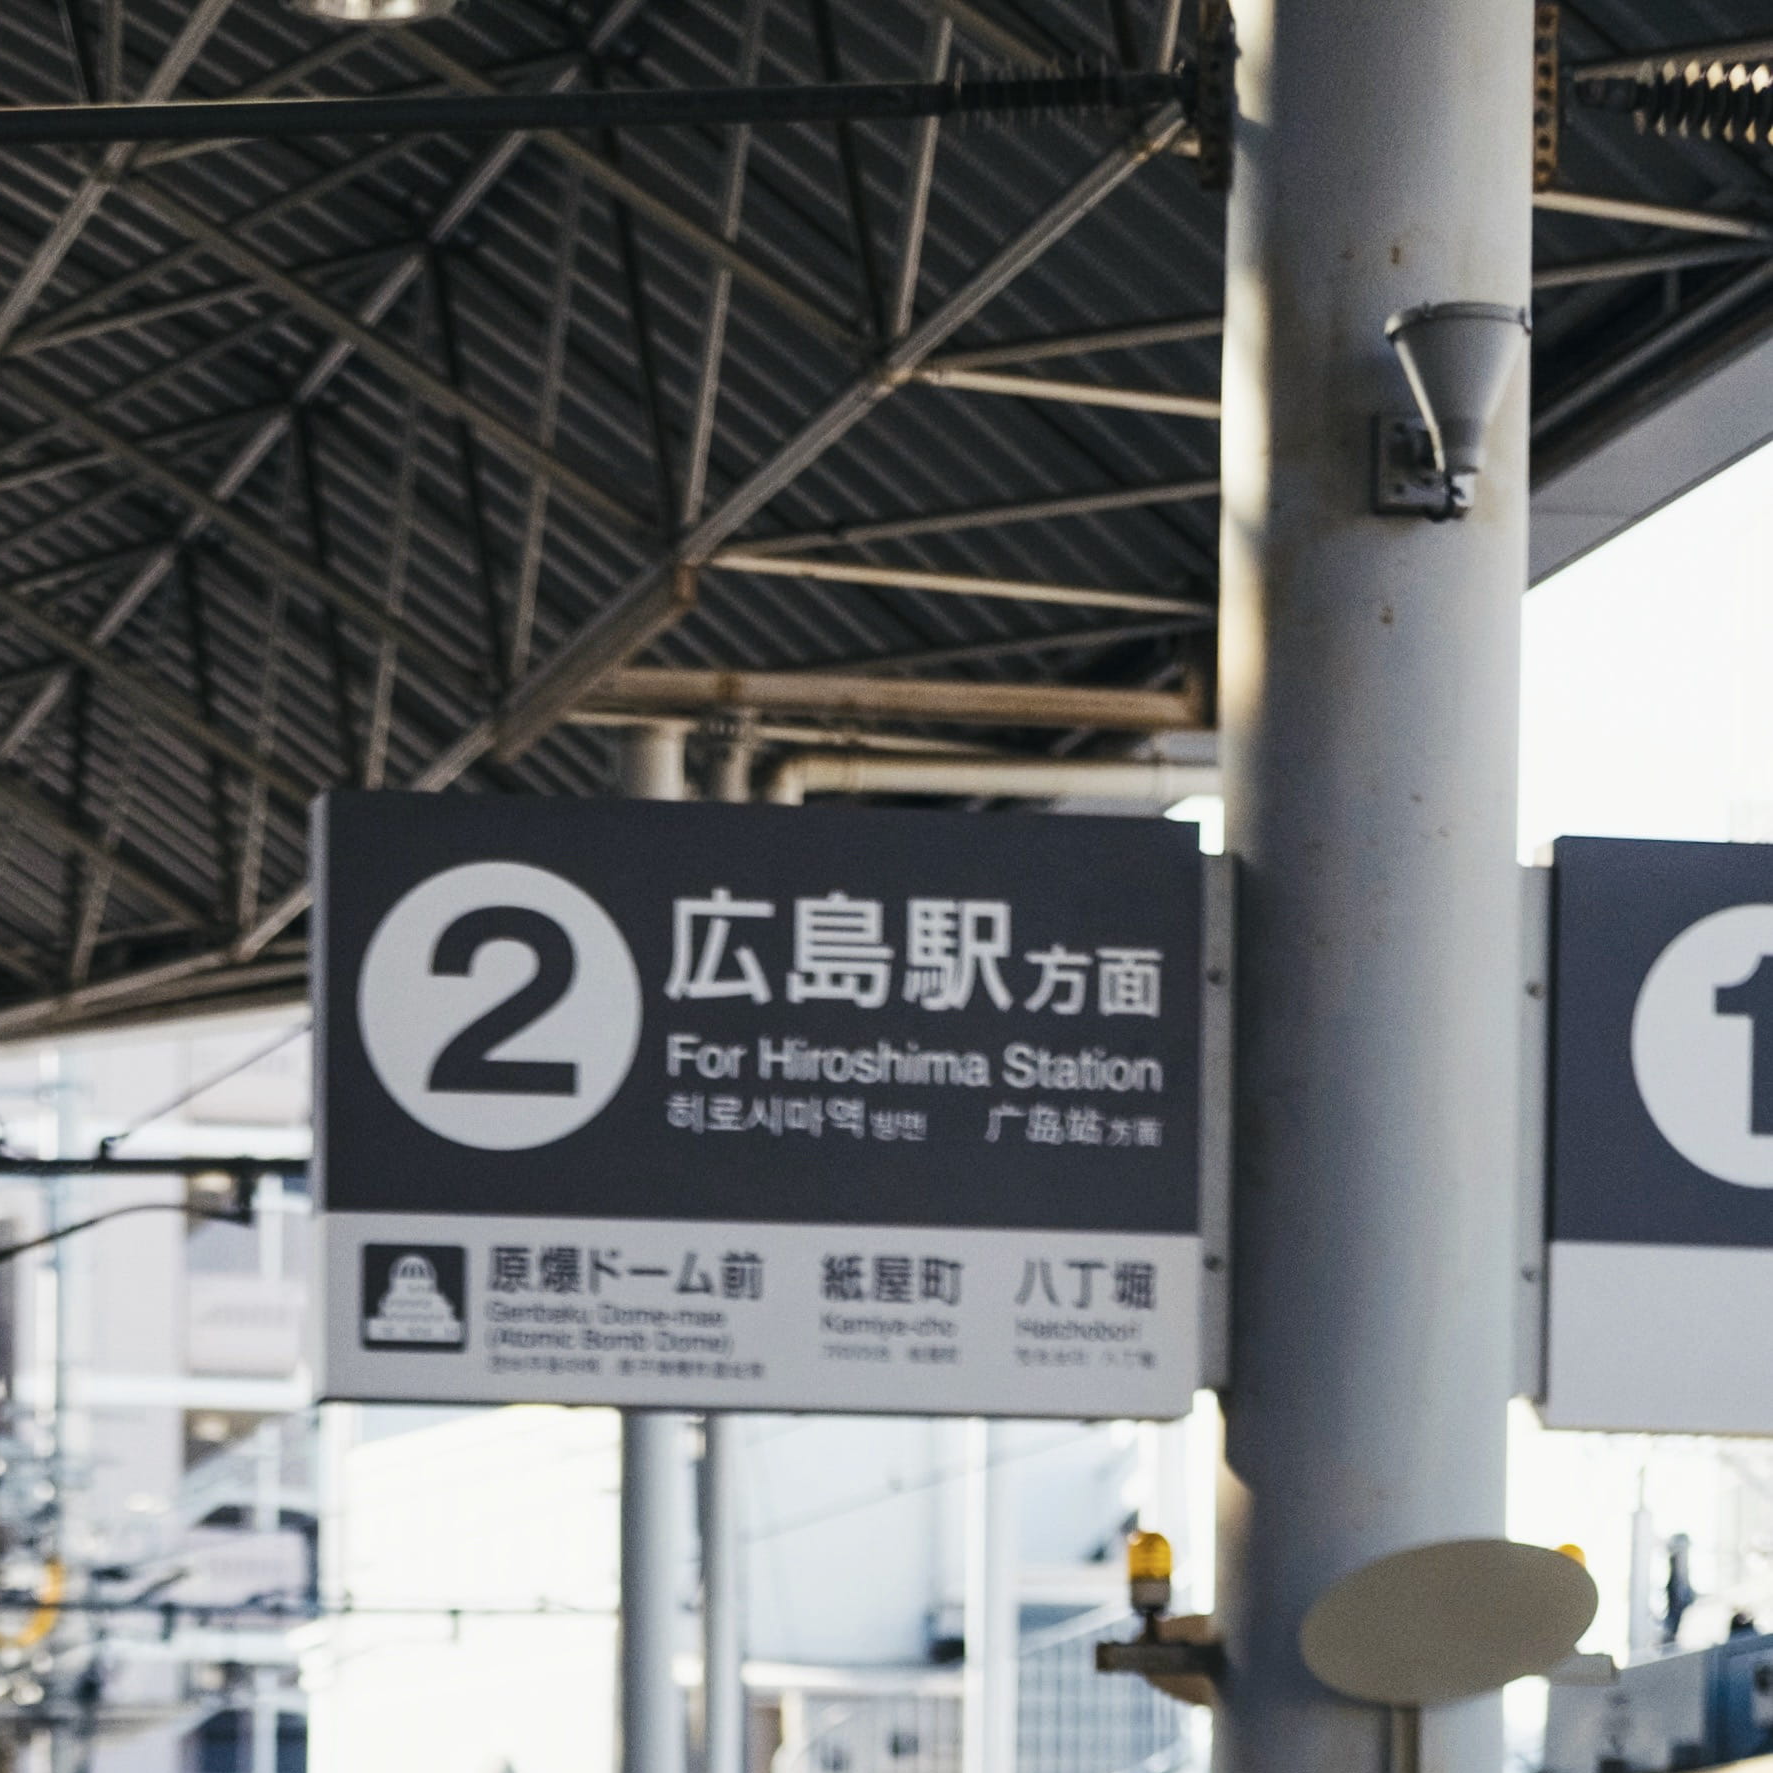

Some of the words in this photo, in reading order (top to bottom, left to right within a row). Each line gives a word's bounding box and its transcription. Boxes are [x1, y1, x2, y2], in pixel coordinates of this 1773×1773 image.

[664, 887, 1164, 1018] 広島駅方面
[426, 905, 578, 1096] 2
[666, 1032, 746, 1080] For
[757, 1037, 991, 1088] Hiroshima
[1002, 1042, 1164, 1093] Station
[487, 1246, 764, 1301] 原爆ドーム前
[821, 1254, 964, 1308] 紙屋町
[1013, 1259, 1157, 1311] 八丁堀
